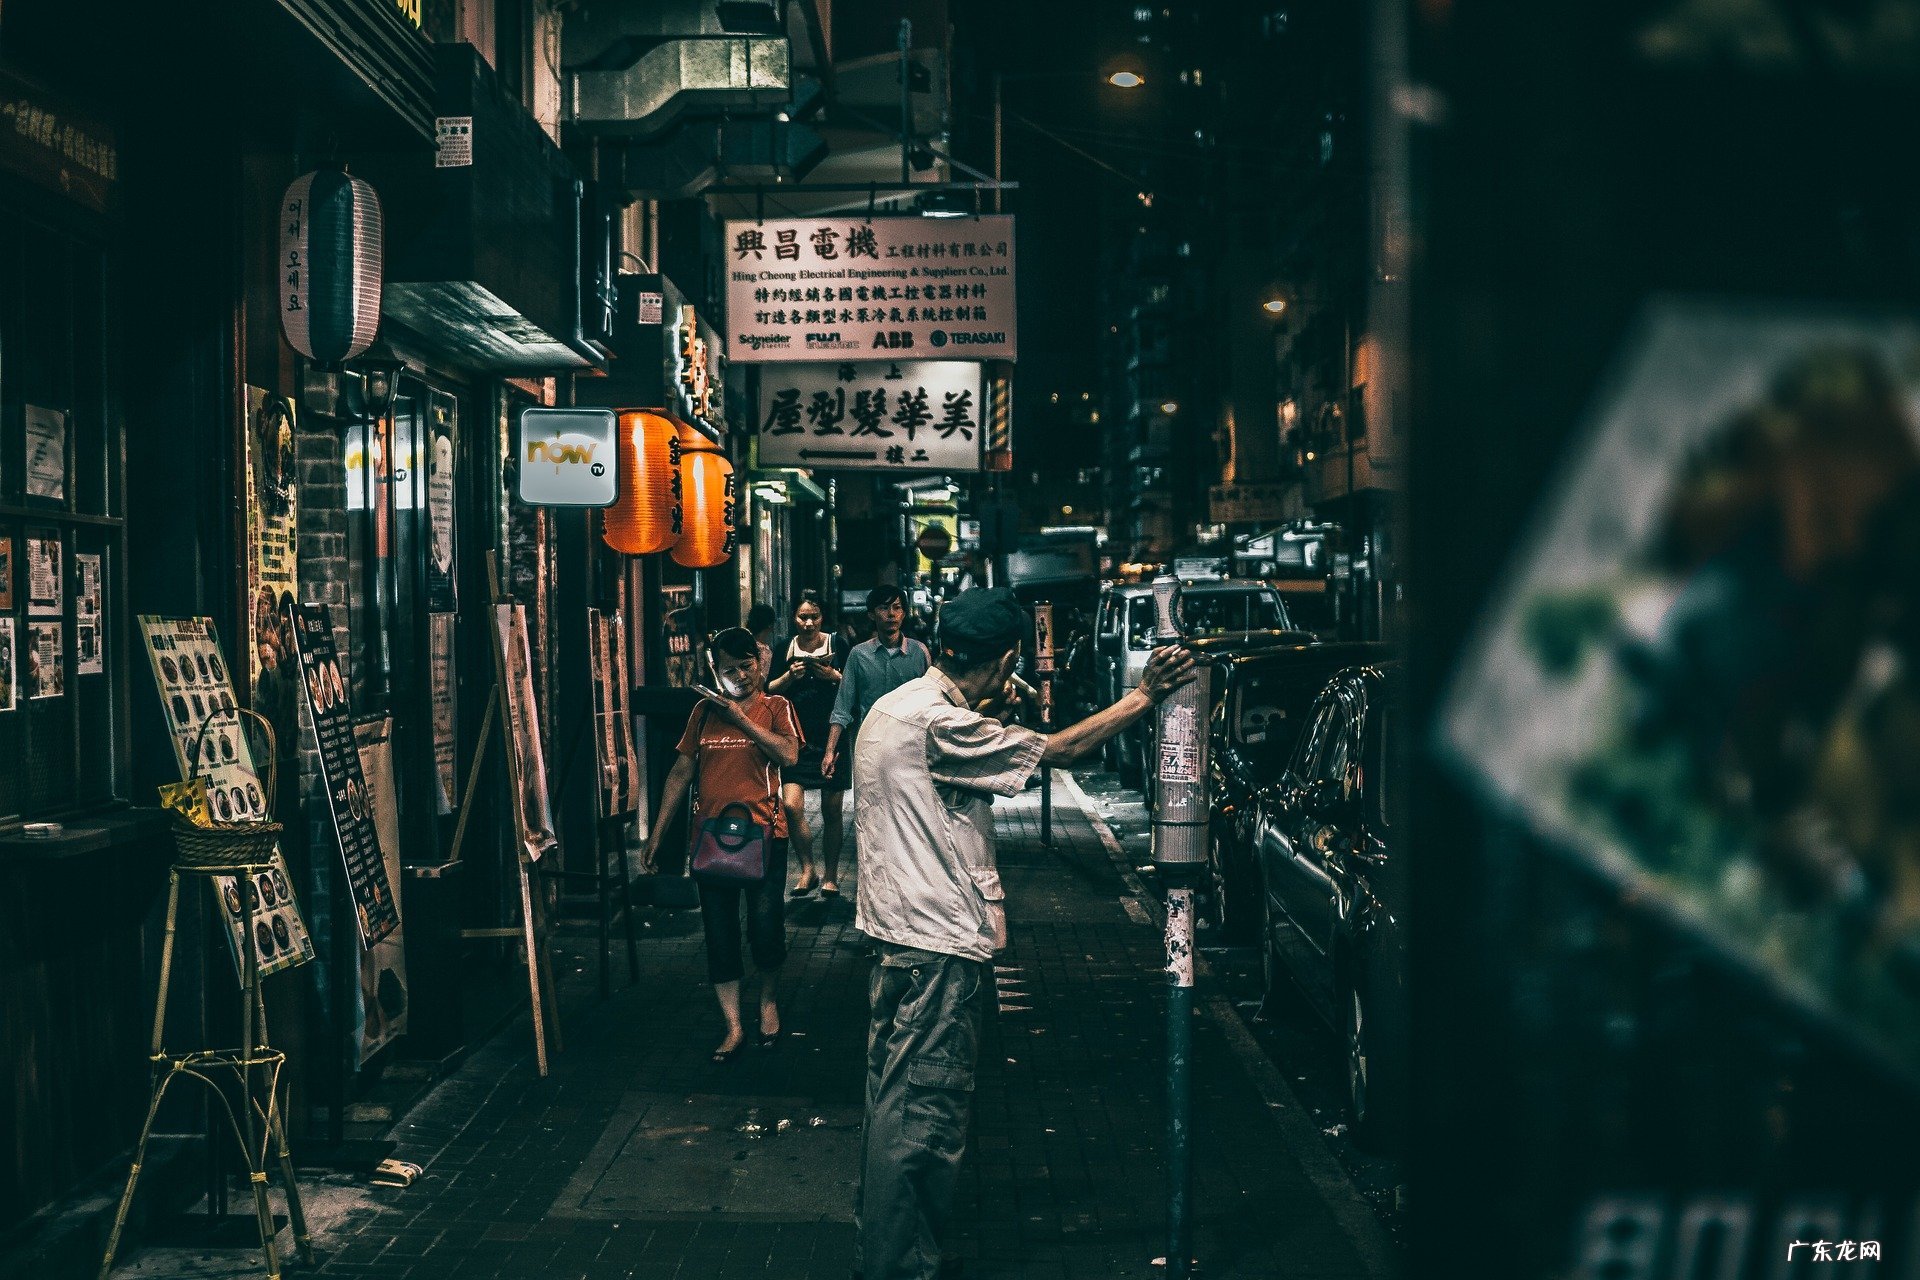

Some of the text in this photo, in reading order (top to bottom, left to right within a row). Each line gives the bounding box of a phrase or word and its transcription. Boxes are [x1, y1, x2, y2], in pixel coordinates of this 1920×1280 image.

[734, 226, 1007, 261] 興昌電機 工程材料有限公司
[286, 199, 302, 312] 어서 오세요
[733, 271, 757, 282] Hing
[760, 271, 797, 281] Cheong
[800, 269, 846, 279] Electrical
[848, 267, 908, 280] Engineering
[910, 267, 919, 276] &
[923, 266, 967, 278] Suppliers
[755, 284, 986, 302] 特約經銷各國電機工控電器材料
[739, 333, 792, 350] Schneider
[872, 331, 915, 349] ABB
[949, 331, 1006, 344] TERASAKI
[527, 441, 597, 464] now
